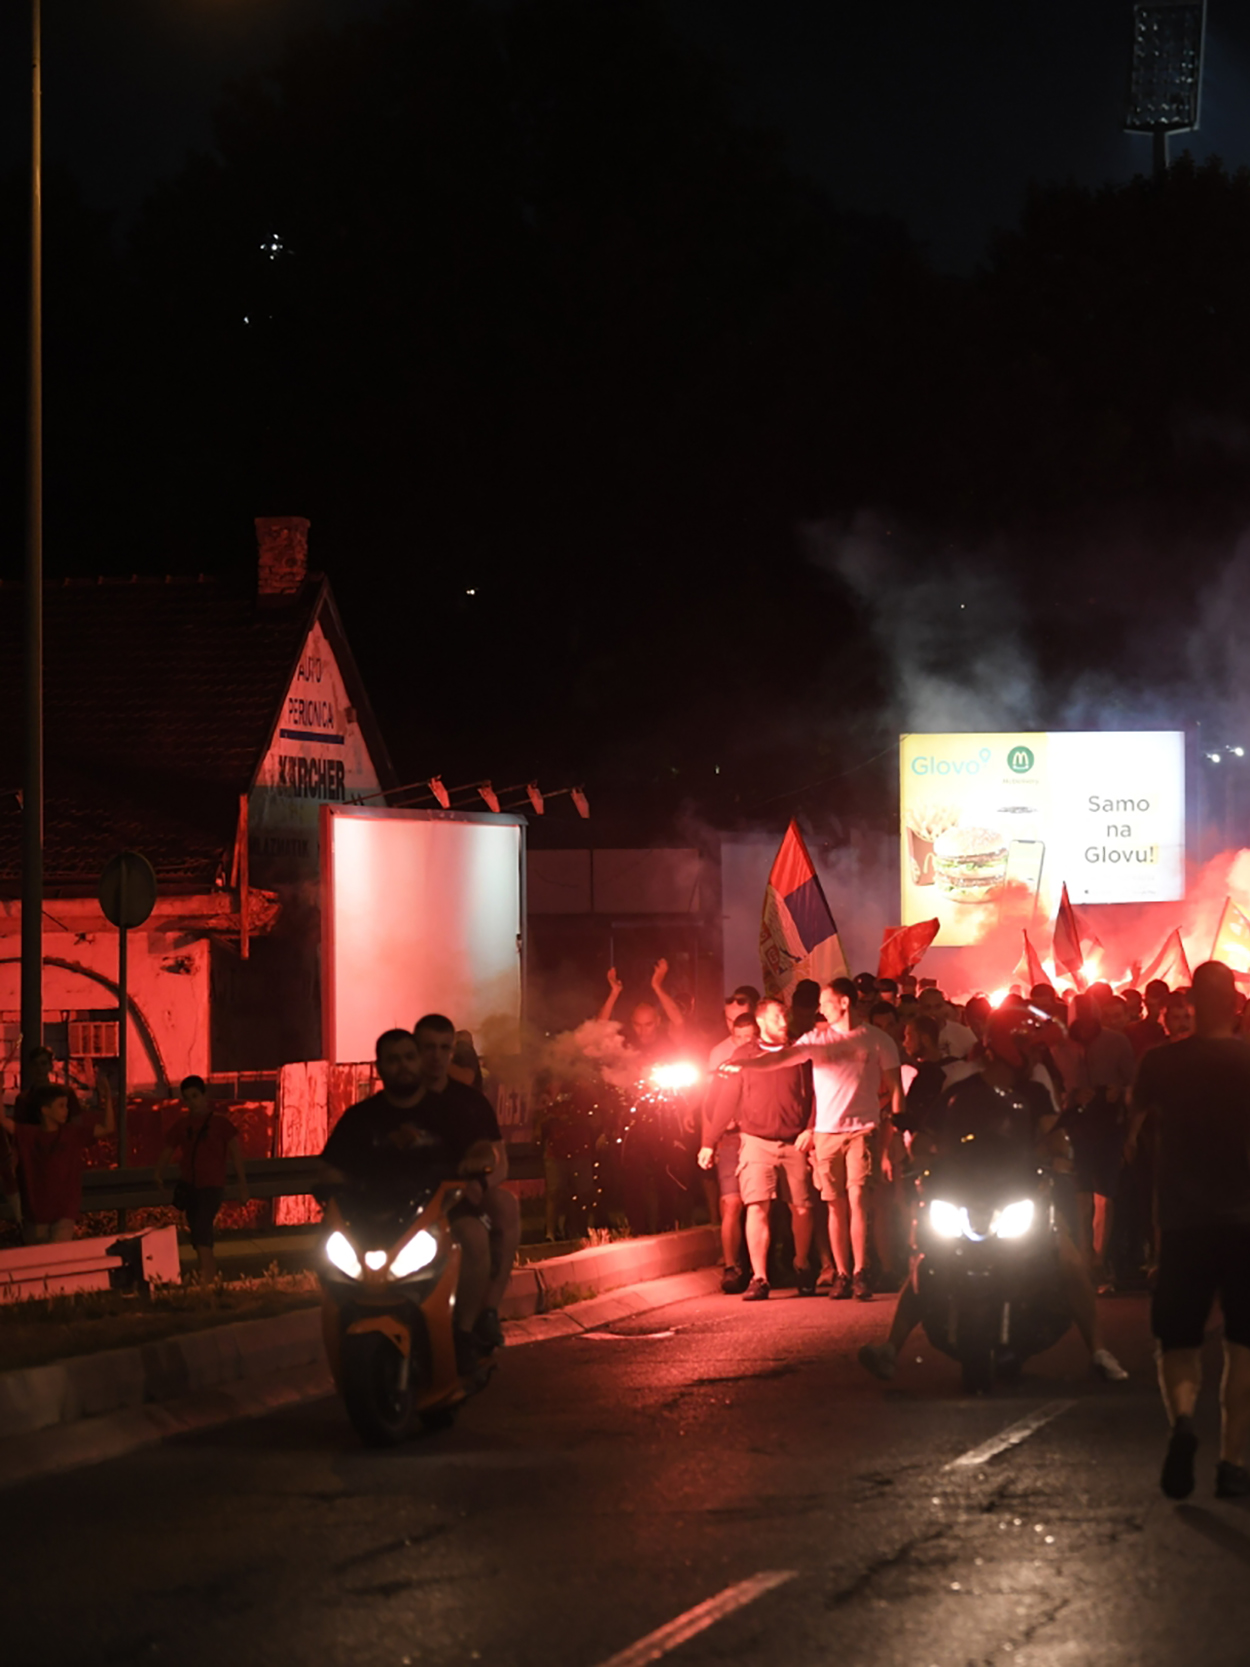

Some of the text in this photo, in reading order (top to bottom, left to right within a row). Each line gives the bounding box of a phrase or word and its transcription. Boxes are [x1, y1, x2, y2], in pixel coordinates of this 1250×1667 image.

[297, 657, 321, 683] AUTO
[289, 698, 334, 729] PERIONICA
[911, 755, 980, 775] Glovo
[1088, 795, 1150, 813] Samo
[1106, 824, 1132, 838] na
[1084, 845, 1155, 864] Glovu!
